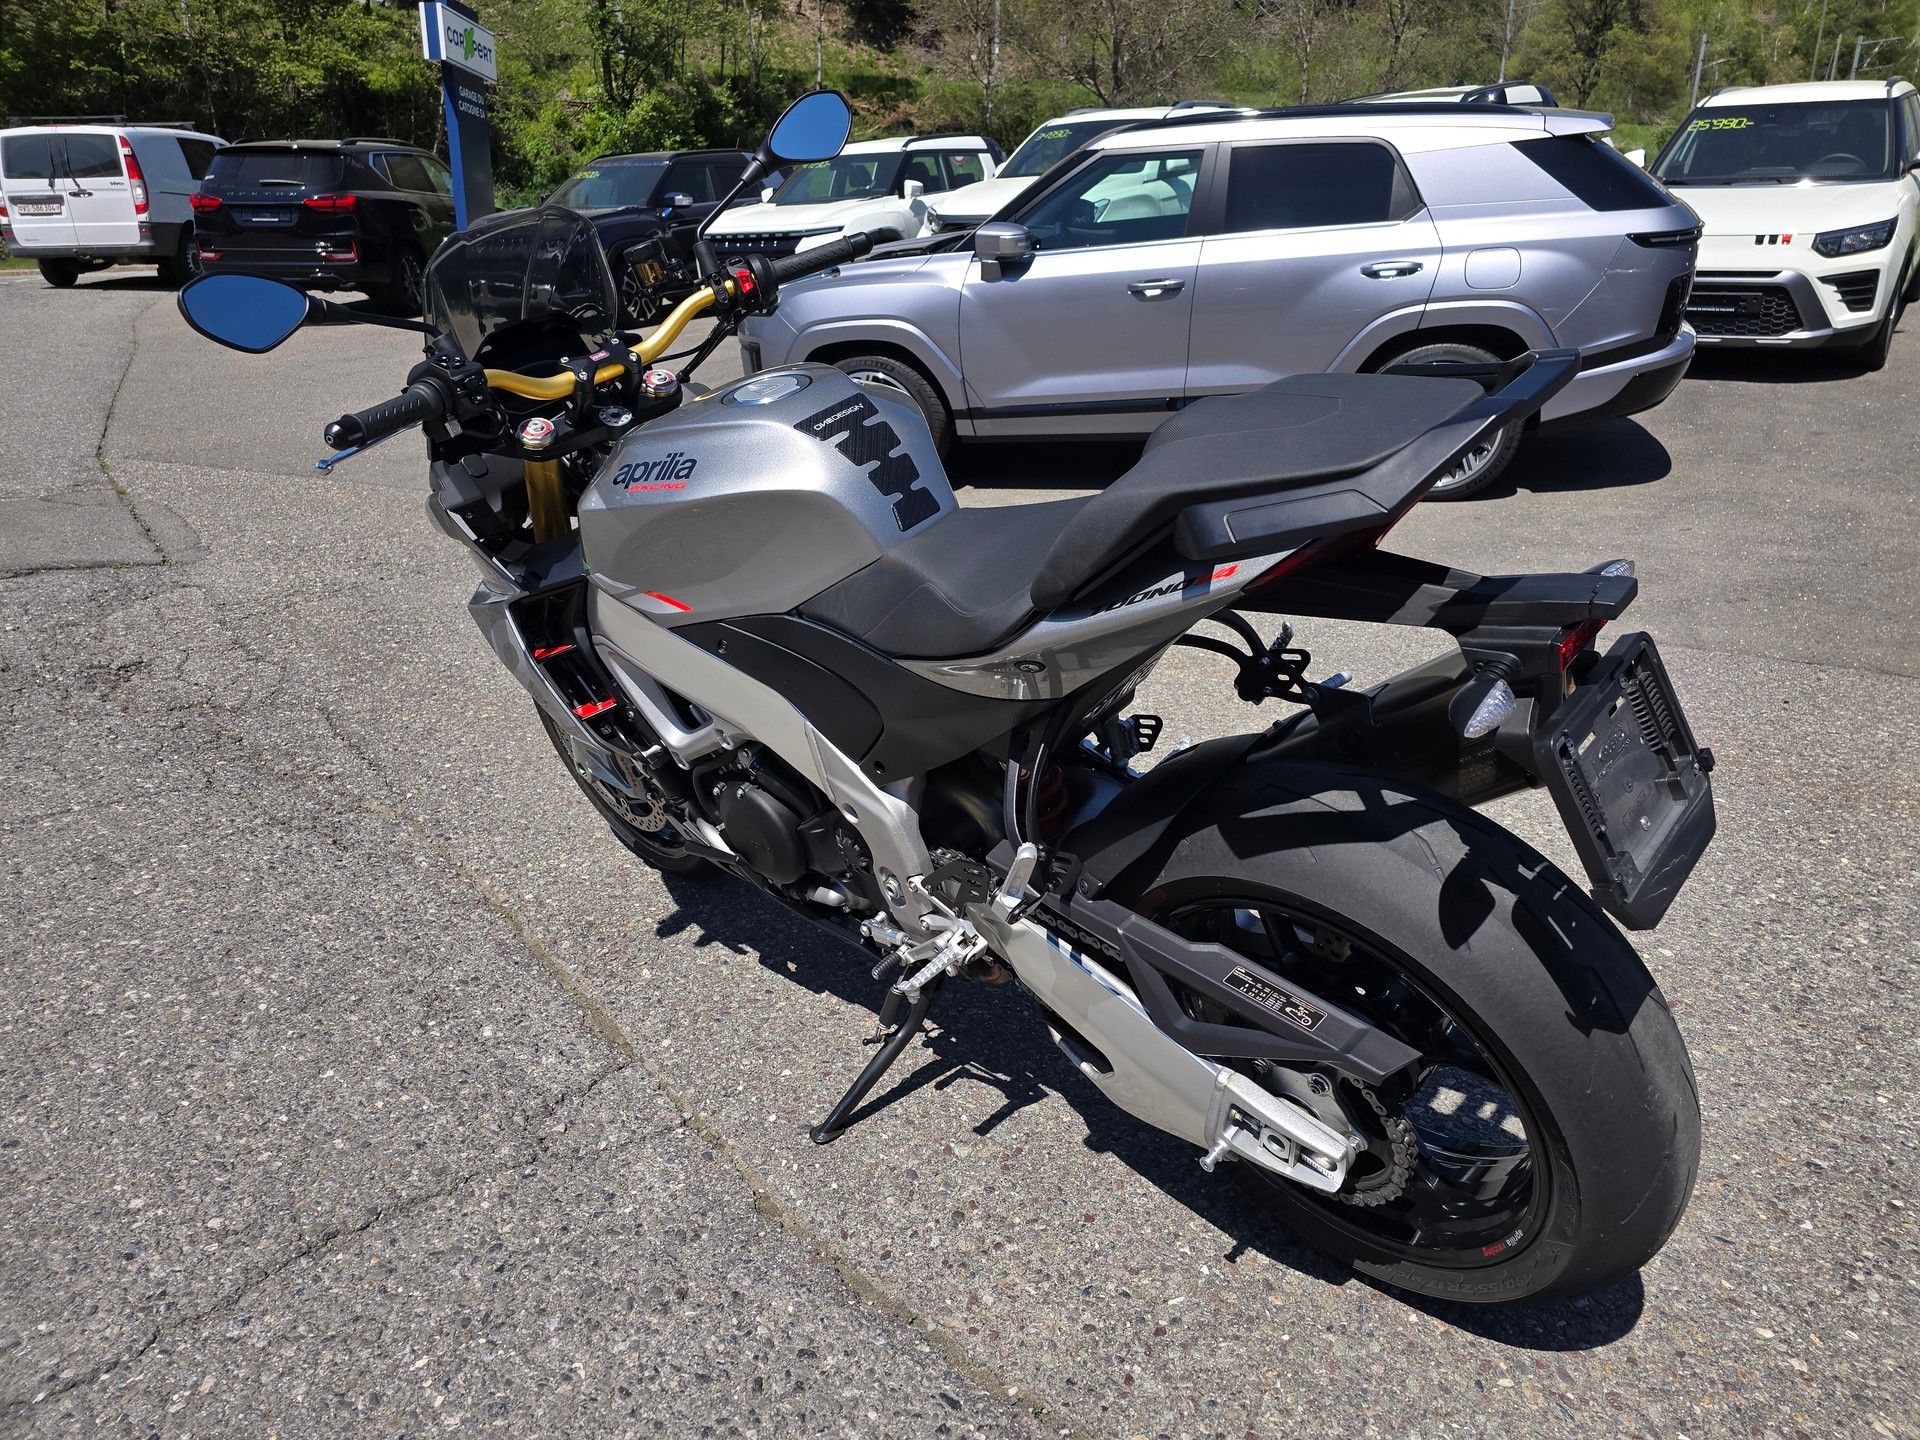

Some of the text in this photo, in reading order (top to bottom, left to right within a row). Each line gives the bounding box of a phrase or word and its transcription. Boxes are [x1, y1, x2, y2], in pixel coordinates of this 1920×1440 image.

[459, 86, 478, 103] GARAGE
[458, 100, 480, 117] CATOGNE
[23, 204, 31, 212] VS
[813, 402, 864, 431] ONEDESIGN
[612, 452, 698, 490] aprilia
[628, 481, 687, 493] RACING
[1481, 1229, 1524, 1257] aprilia racing
